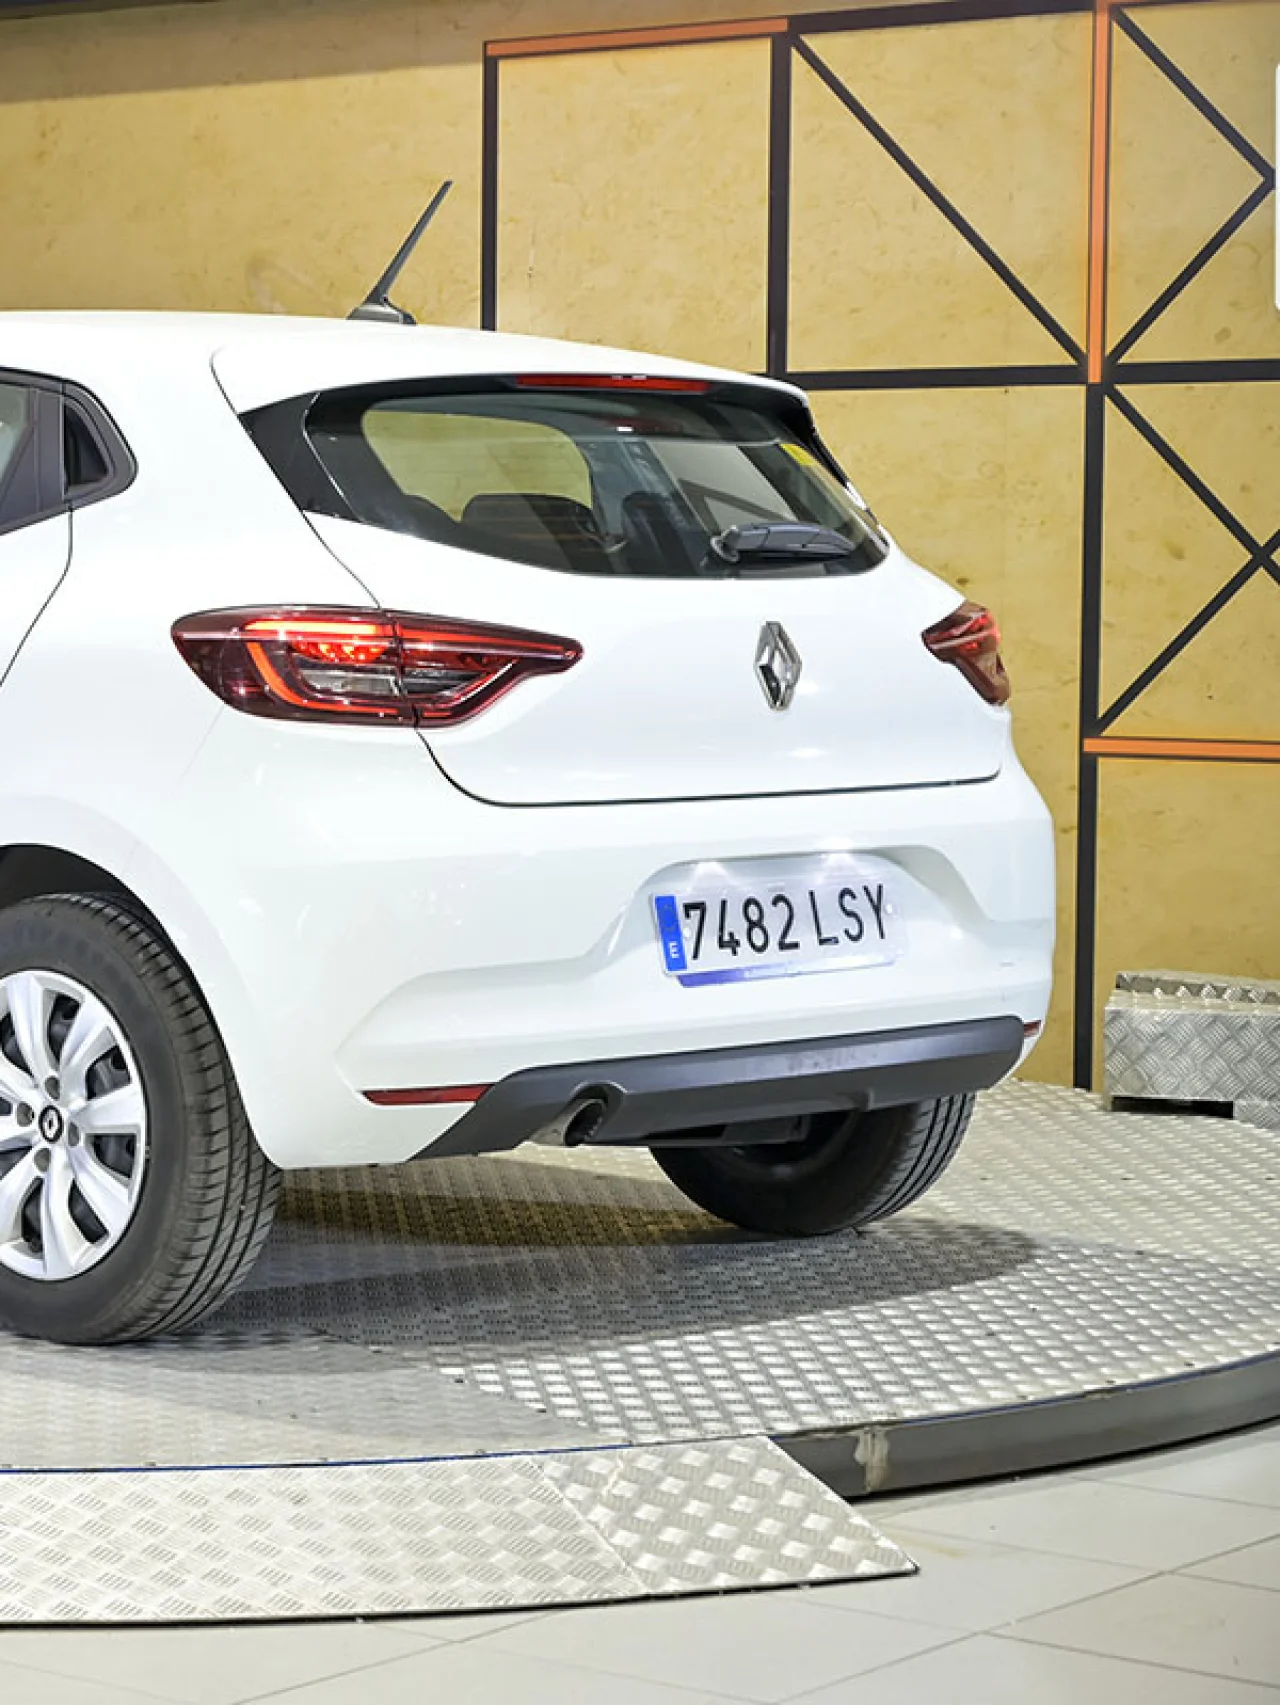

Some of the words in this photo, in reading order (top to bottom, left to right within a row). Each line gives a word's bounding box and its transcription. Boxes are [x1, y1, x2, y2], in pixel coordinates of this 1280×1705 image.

[668, 941, 681, 960] E
[682, 893, 801, 961] 7482
[807, 883, 886, 947] LSY
